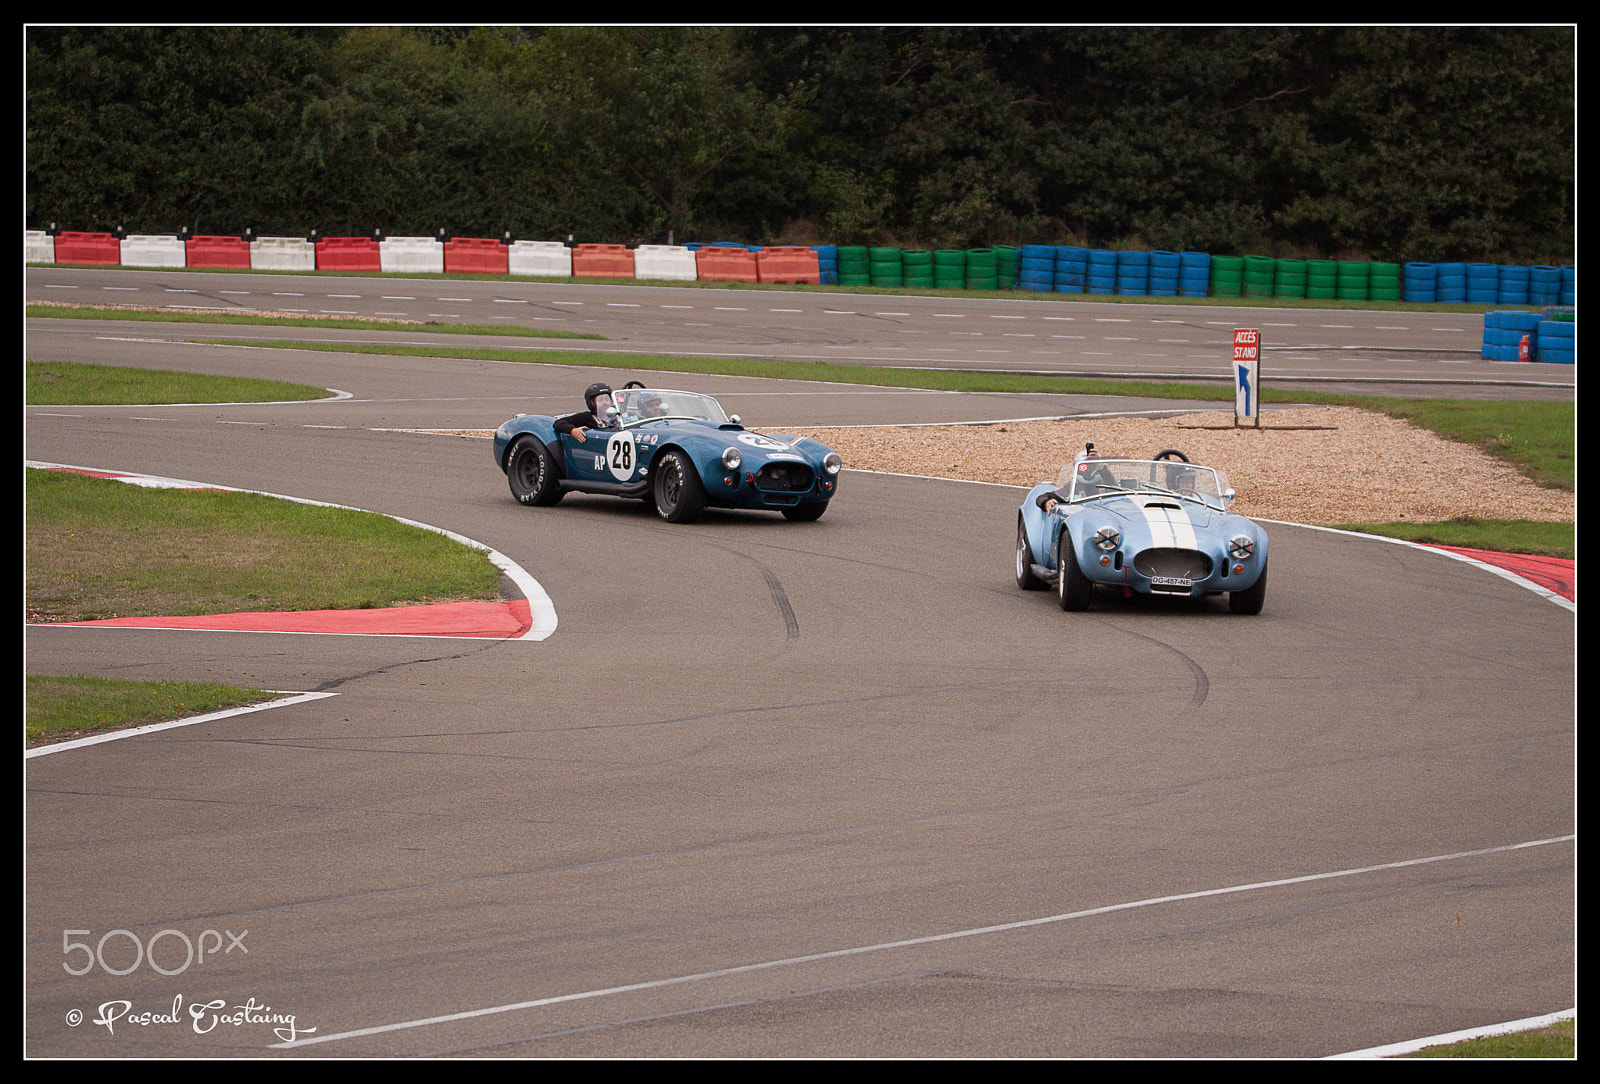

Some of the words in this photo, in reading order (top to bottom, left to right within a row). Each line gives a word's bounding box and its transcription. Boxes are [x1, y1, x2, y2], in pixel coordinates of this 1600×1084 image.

[1235, 330, 1256, 343] ACCÈS
[1234, 346, 1257, 358] STAND
[594, 455, 606, 471] AP
[612, 440, 631, 470] 28
[521, 454, 545, 502] GOODYEAR
[1152, 577, 1191, 586] DG-457-NE
